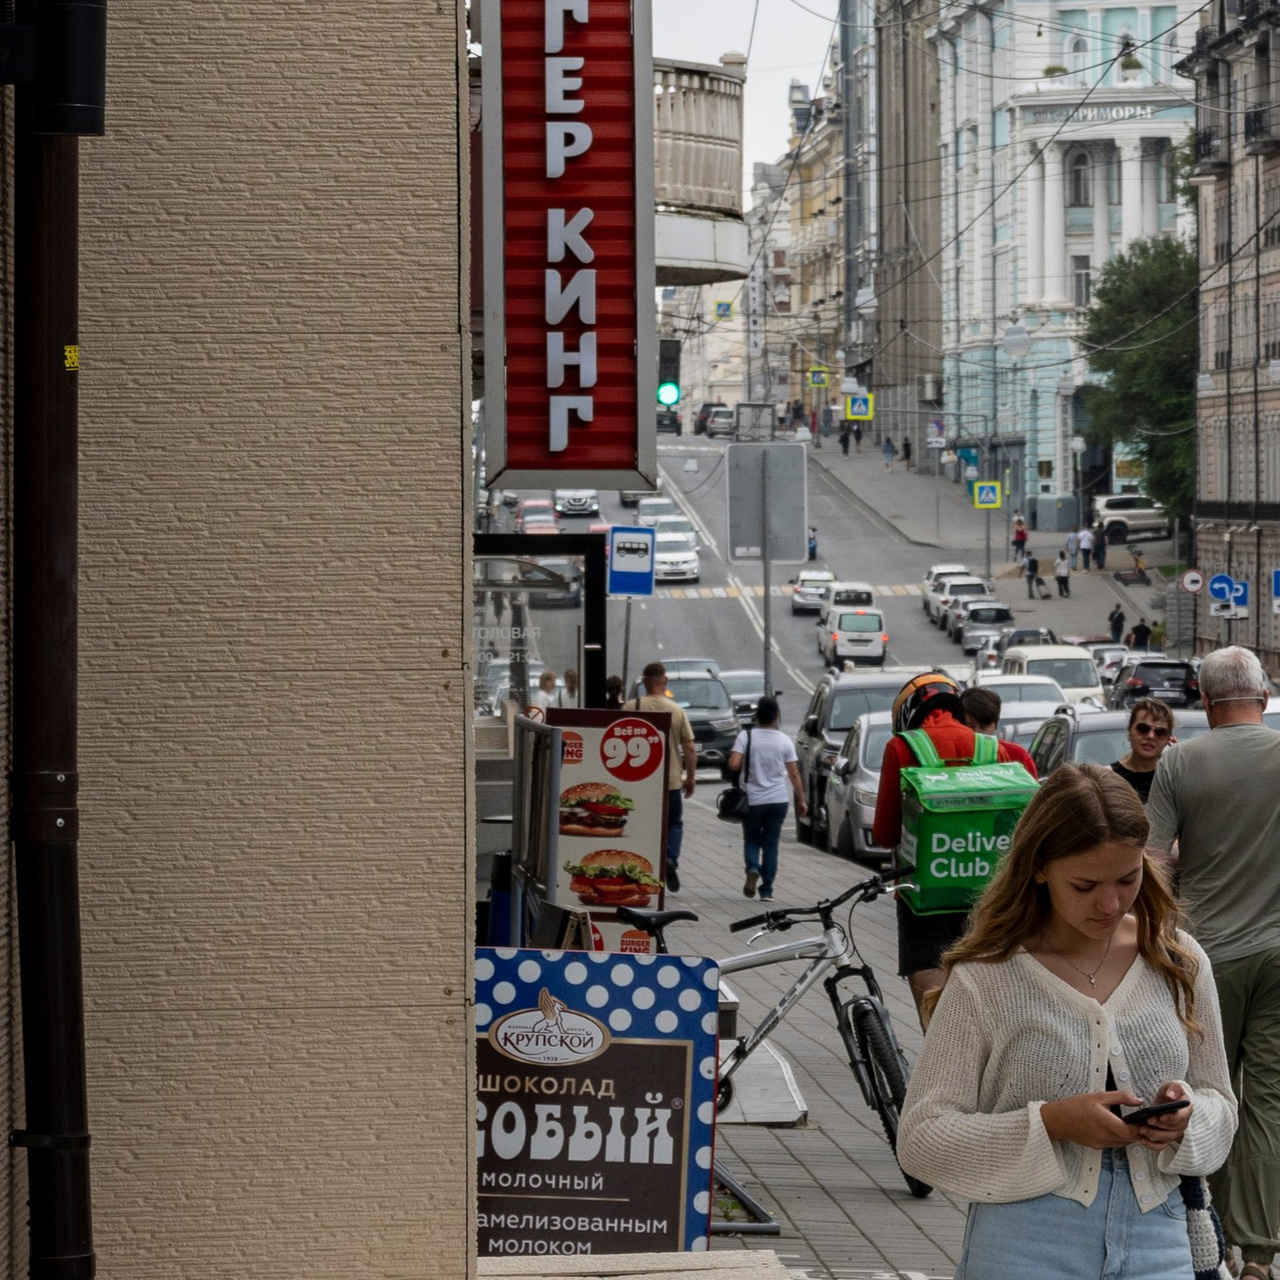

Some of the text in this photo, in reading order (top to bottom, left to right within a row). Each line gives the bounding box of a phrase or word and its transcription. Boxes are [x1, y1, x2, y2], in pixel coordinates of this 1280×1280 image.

[545, 207, 598, 453] КИНГ
[929, 856, 991, 879] Club
[620, 939, 651, 948] BURGER
[502, 1031, 594, 1053] КРУПСКОЙ
[478, 1074, 616, 1100] ШОКОЛАД
